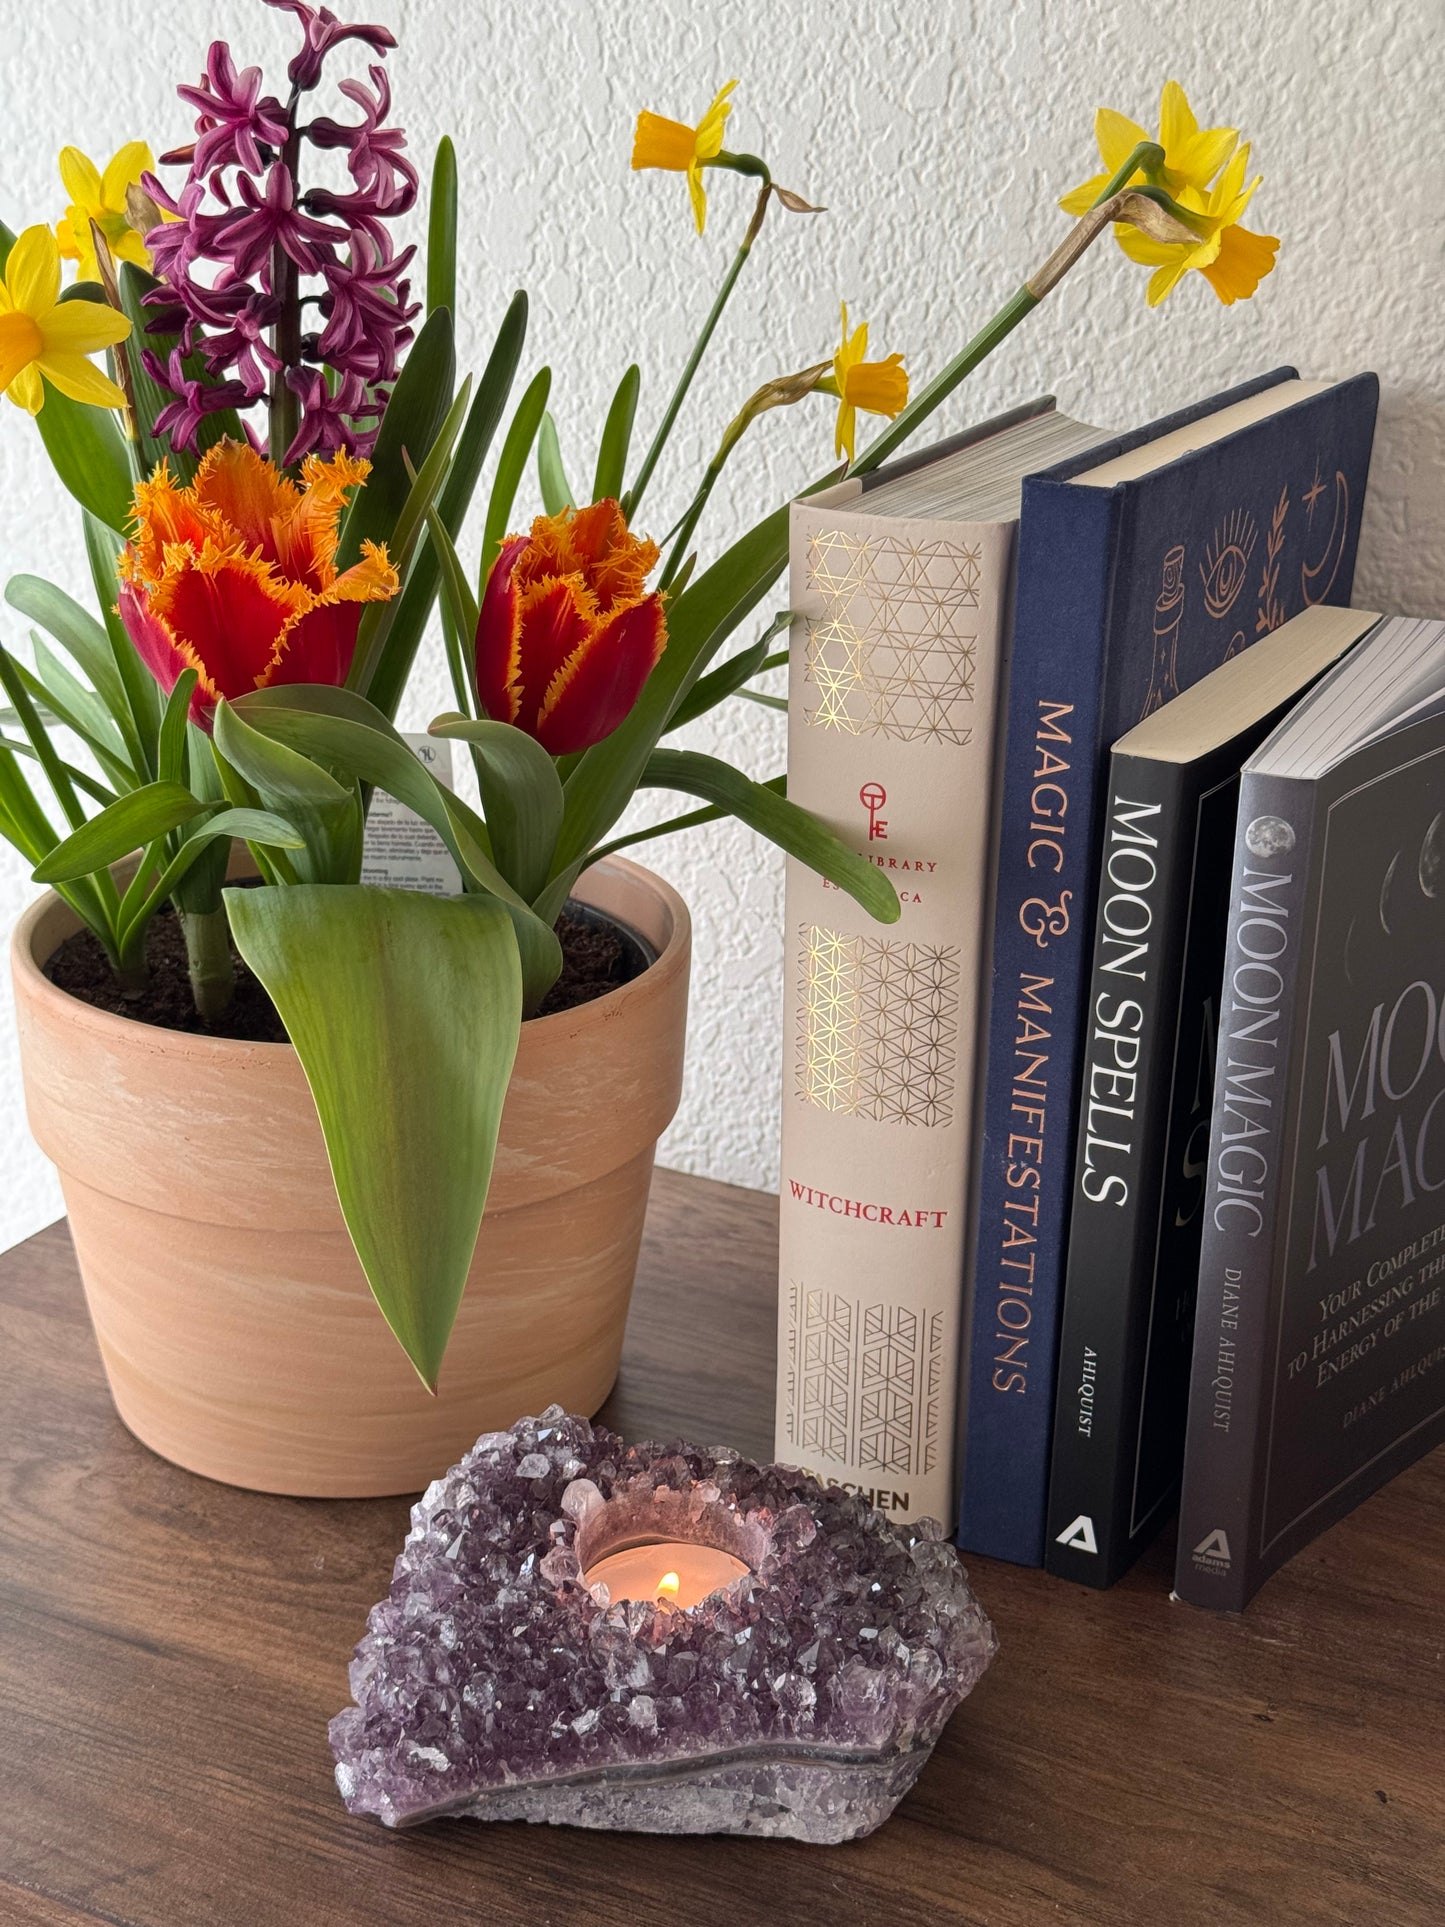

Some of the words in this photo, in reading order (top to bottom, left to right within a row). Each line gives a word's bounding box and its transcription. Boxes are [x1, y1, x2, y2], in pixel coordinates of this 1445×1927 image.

[1027, 699, 1074, 873] MAGIC
[858, 853, 938, 873] IBRARY
[1100, 795, 1163, 982] MOON
[1019, 890, 1073, 948] &
[1226, 866, 1293, 1048] MOON
[1080, 991, 1144, 1207] SPELLS
[1317, 981, 1445, 1150] MO
[992, 972, 1055, 1395] MANIFESTATIONS
[1213, 1057, 1276, 1238] MAGIC
[788, 1178, 948, 1229] WITCHCRAFT
[1221, 1268, 1242, 1330] DIANE
[1287, 1352, 1307, 1379] TO
[1311, 1276, 1414, 1360] HARNESSING
[1316, 1328, 1380, 1388] ENERGY
[1383, 1312, 1404, 1338] OF
[1408, 1287, 1441, 1320] THE
[1319, 1281, 1361, 1322] YOUR
[1078, 1346, 1097, 1438] AHLQUIST
[1212, 1336, 1236, 1433] AHLQUIST
[1343, 1387, 1386, 1428] DIANE
[1191, 1554, 1231, 1569] adams
[1194, 1563, 1227, 1577] media
